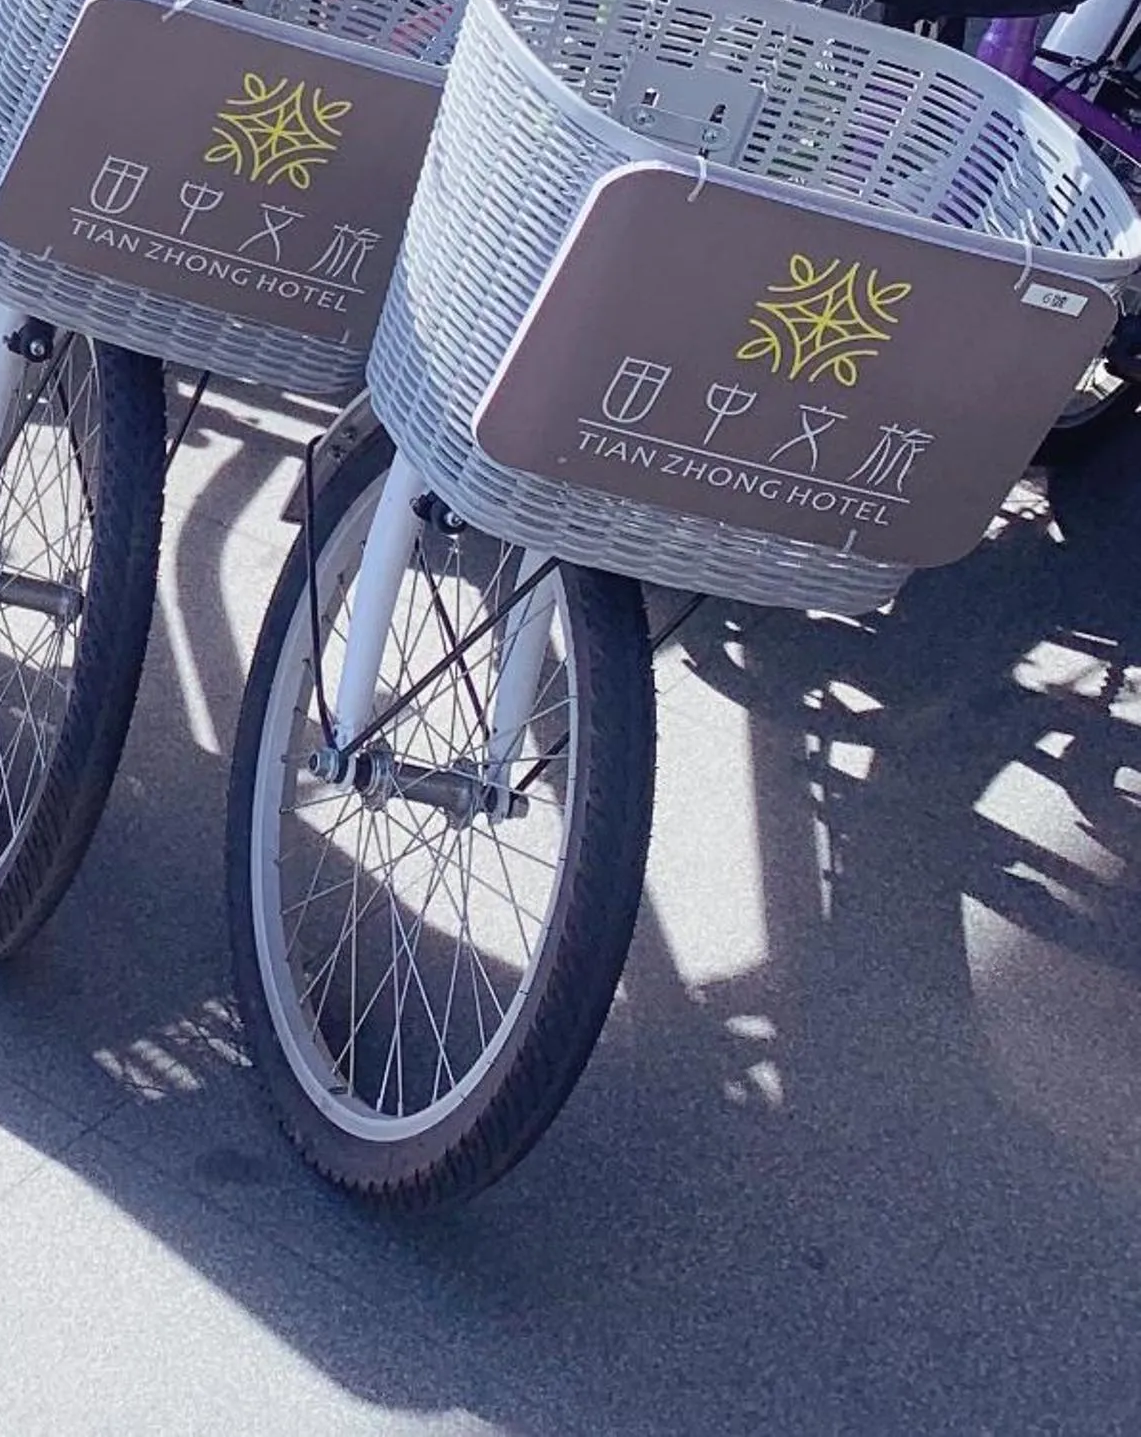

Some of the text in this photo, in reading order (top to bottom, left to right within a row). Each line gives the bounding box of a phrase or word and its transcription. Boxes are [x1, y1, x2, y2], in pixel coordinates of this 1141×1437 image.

[70, 217, 348, 313] TIAN ZHONG HOTEL
[578, 430, 890, 526] TIAN ZHONG HOTEL
